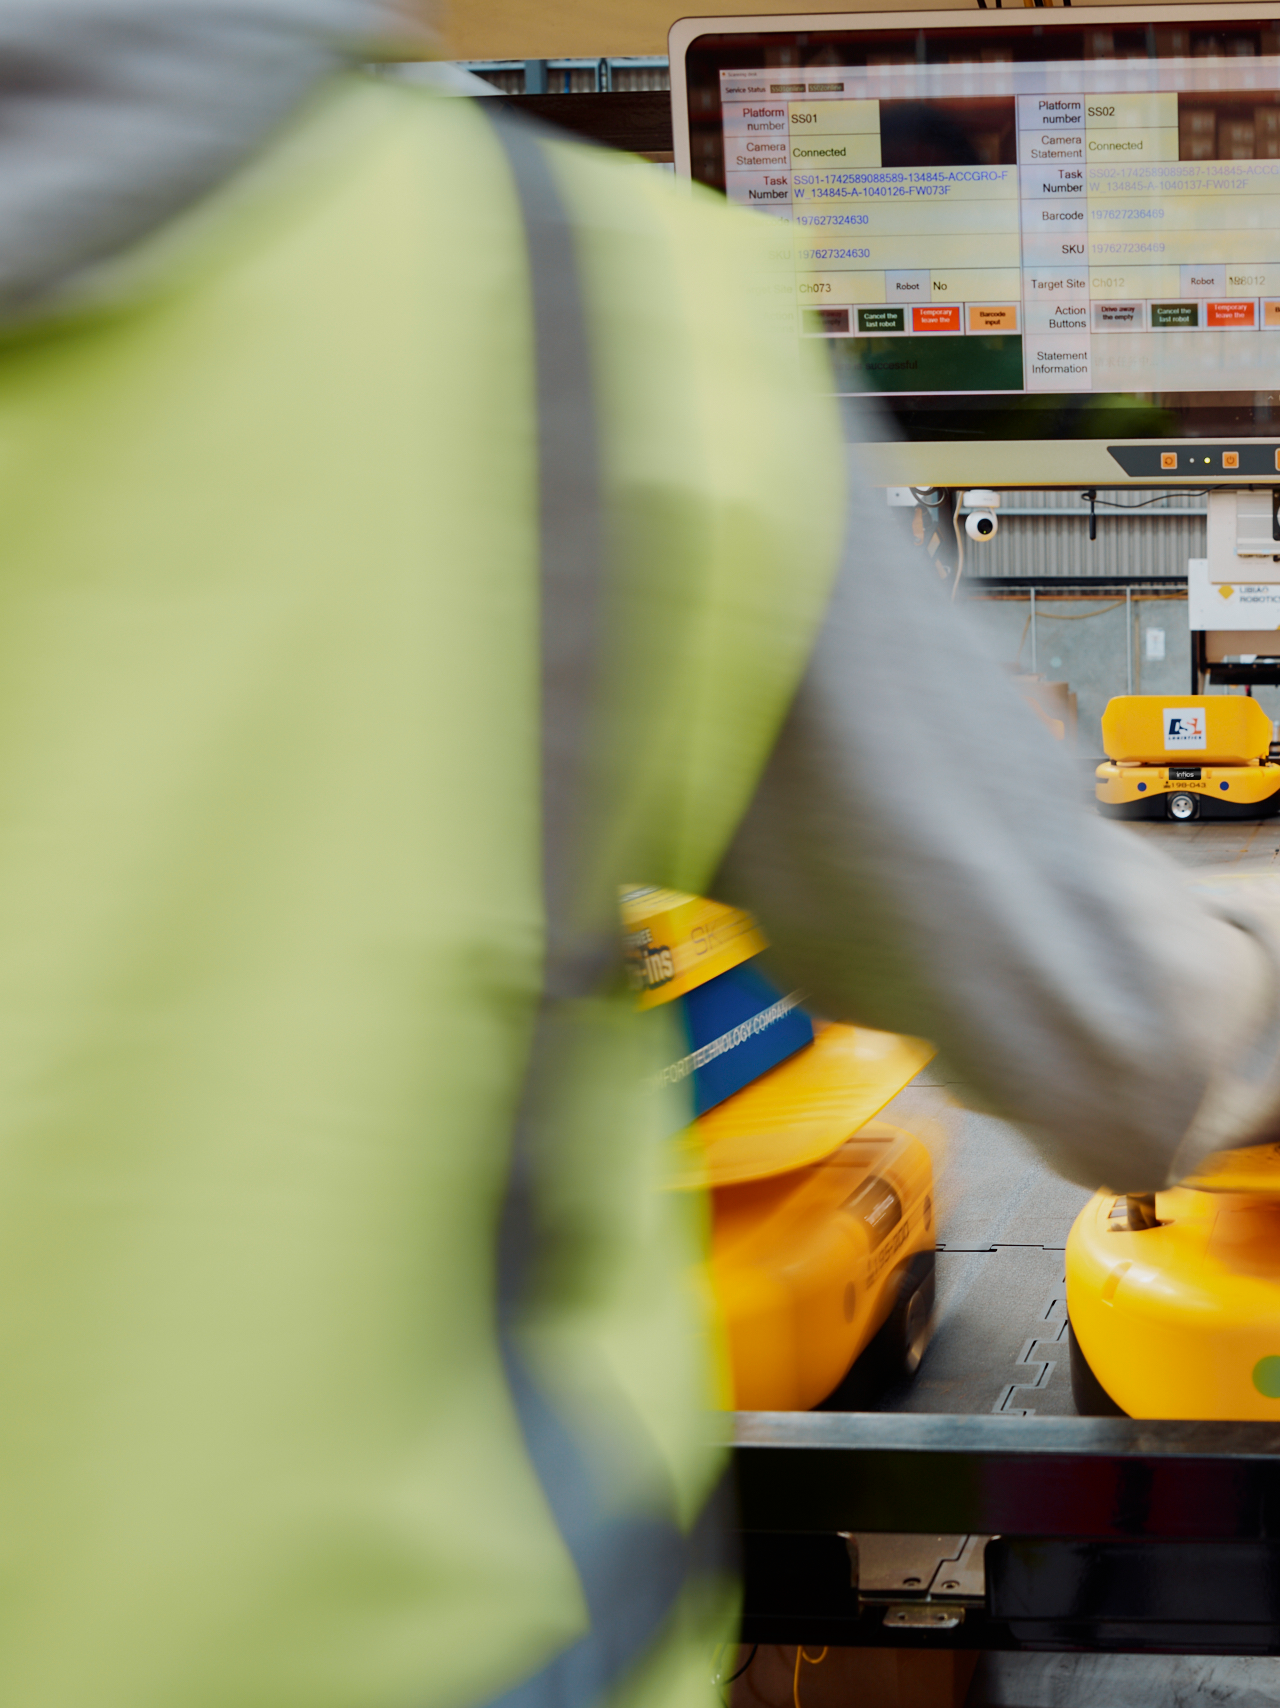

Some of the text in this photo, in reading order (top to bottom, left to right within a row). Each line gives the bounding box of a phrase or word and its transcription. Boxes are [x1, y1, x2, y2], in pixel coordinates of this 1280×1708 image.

[1038, 100, 1081, 112] Platform
[1087, 106, 1115, 117] SS02
[742, 107, 785, 119] Platform
[791, 113, 818, 124] SS01
[1042, 113, 1081, 124] number
[747, 120, 785, 131] number
[1041, 135, 1082, 146] Camera
[1088, 140, 1143, 151] Connected
[746, 141, 786, 153] Camera
[792, 147, 847, 158] Connected
[1031, 147, 1083, 159] Statement
[736, 155, 787, 166] Statement
[793, 170, 1008, 186] SS01-1742589088589-134845-ACCGRO-F
[1058, 168, 1083, 179] Task
[763, 175, 788, 187] Task
[794, 185, 951, 200] W_134845-A-1040126-FW073F
[1042, 182, 1083, 193] Number
[748, 189, 789, 200] Number
[795, 214, 869, 226] 197627324630
[1041, 210, 1084, 221] Barcode
[1061, 244, 1085, 254] SKU
[895, 282, 920, 291] Robot
[933, 281, 948, 291] No
[1031, 278, 1086, 291] Target Site
[1091, 277, 1125, 288] Ch012
[1190, 276, 1215, 286] Robot
[799, 283, 832, 294] Ch073
[919, 308, 953, 318] Temporary
[1054, 305, 1087, 316] Action
[1101, 306, 1135, 315] Drive away
[1157, 307, 1192, 315] Cancel the
[1213, 303, 1248, 313] Temporary
[863, 312, 898, 320] Cancel the
[921, 316, 951, 324] leave the
[1102, 313, 1134, 322] the empty
[1159, 315, 1190, 323] last robot
[1215, 311, 1231, 319] leave
[865, 320, 879, 328] last
[984, 318, 1001, 326] input
[1049, 318, 1087, 329] Buttons
[1036, 350, 1088, 361] Statement
[865, 360, 918, 371] successful
[1032, 363, 1088, 374] Information
[1168, 717, 1203, 735] DSL
[692, 1020, 752, 1069] TECHNOLOGY
